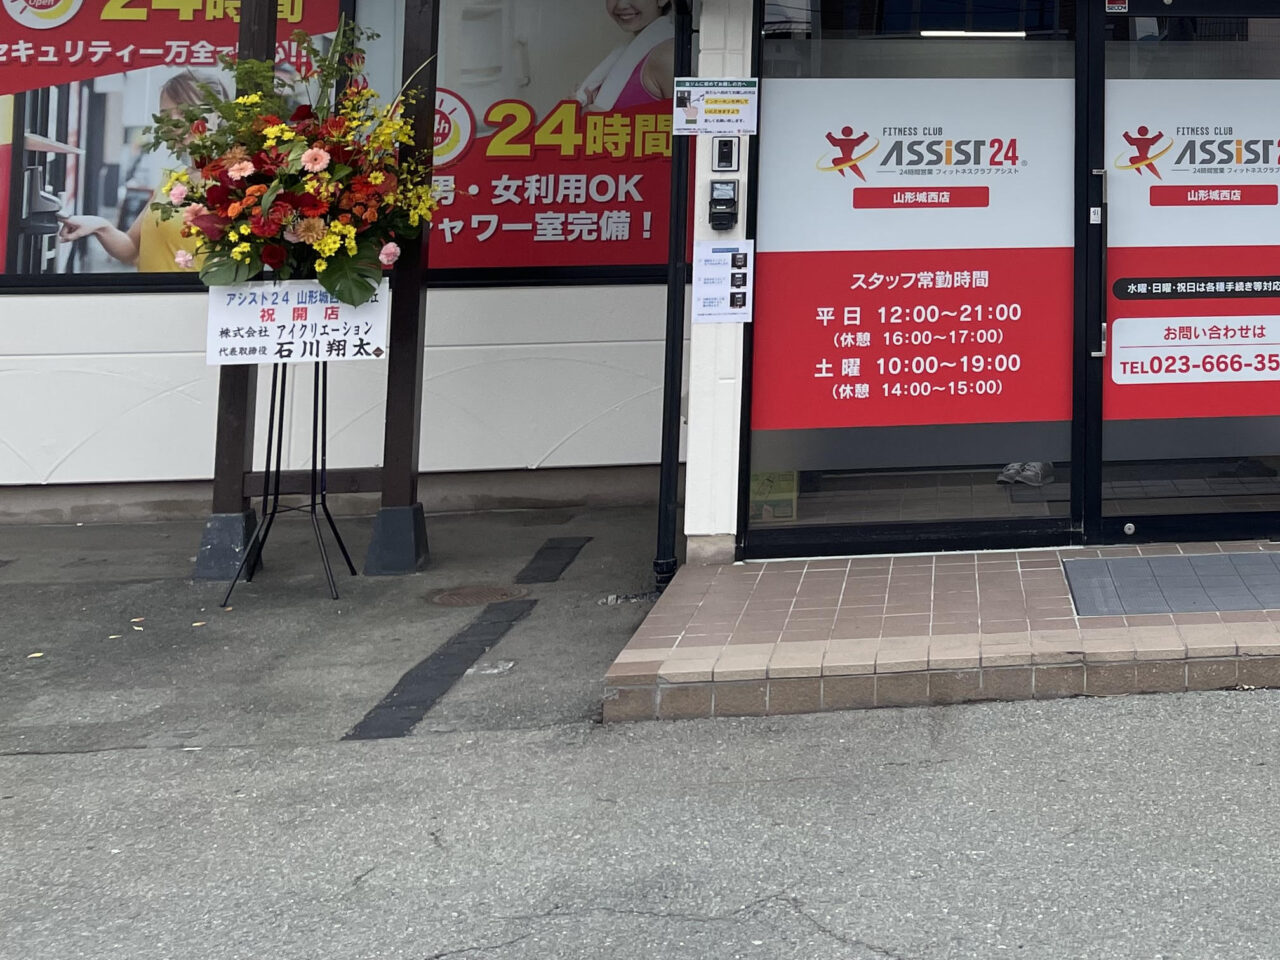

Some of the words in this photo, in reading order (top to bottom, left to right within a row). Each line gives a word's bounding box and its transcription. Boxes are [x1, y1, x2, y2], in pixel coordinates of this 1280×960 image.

[486, 102, 673, 158] 24時間
[882, 127, 918, 136] FITNESS
[922, 127, 943, 136] CLUB
[1176, 126, 1210, 136] FITNESS
[1214, 126, 1233, 135] CLUB
[893, 192, 950, 204] 山形城西店
[1187, 189, 1241, 201] 山形城西店
[429, 211, 652, 244] ャワー室完備！
[850, 270, 989, 290] スタッフ常勤時間
[226, 291, 289, 306] アシスト24
[219, 326, 270, 339] 株式会社
[276, 321, 373, 340] アイクリエーション
[1163, 324, 1266, 340] お問い合わせは
[218, 346, 268, 357] 代表取締役
